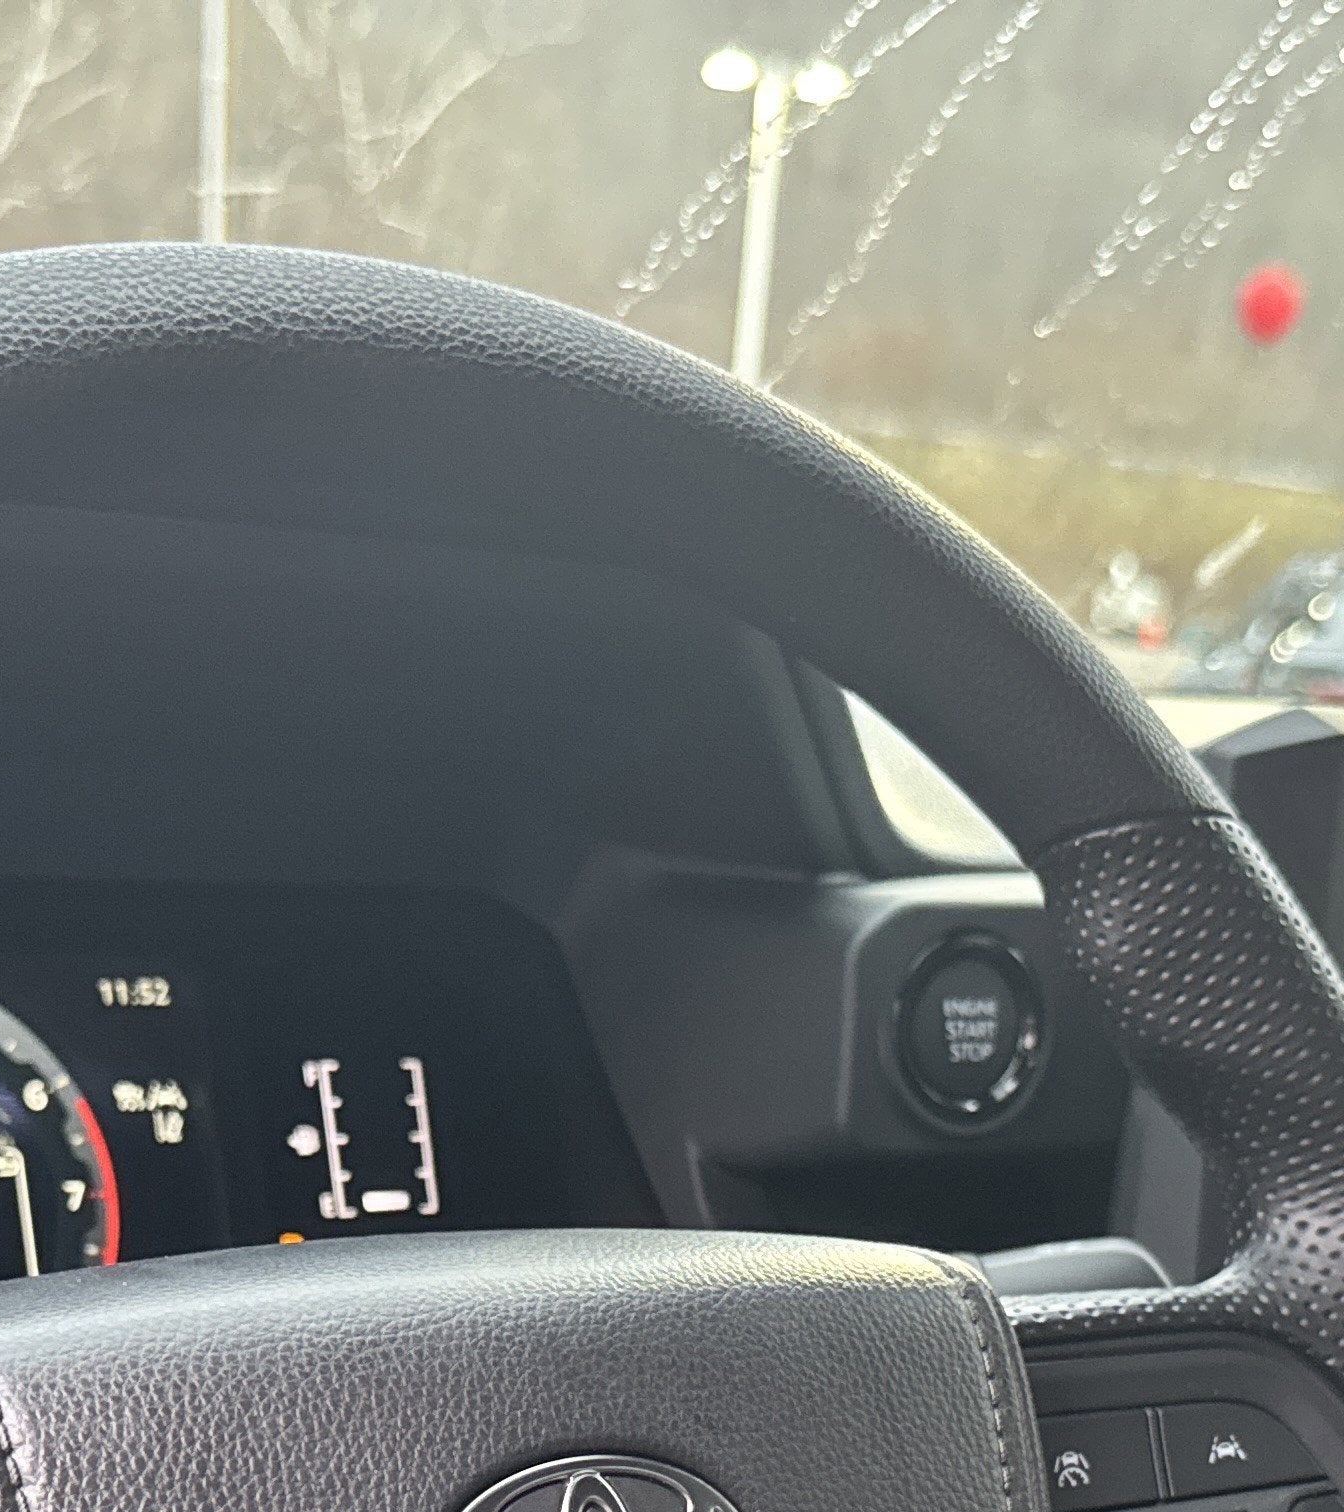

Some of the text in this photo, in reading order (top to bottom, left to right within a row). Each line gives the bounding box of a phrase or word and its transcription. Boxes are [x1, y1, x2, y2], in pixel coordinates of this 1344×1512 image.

[96, 977, 172, 1007] 11:52
[22, 1079, 50, 1112] 6
[61, 1179, 86, 1212] 7
